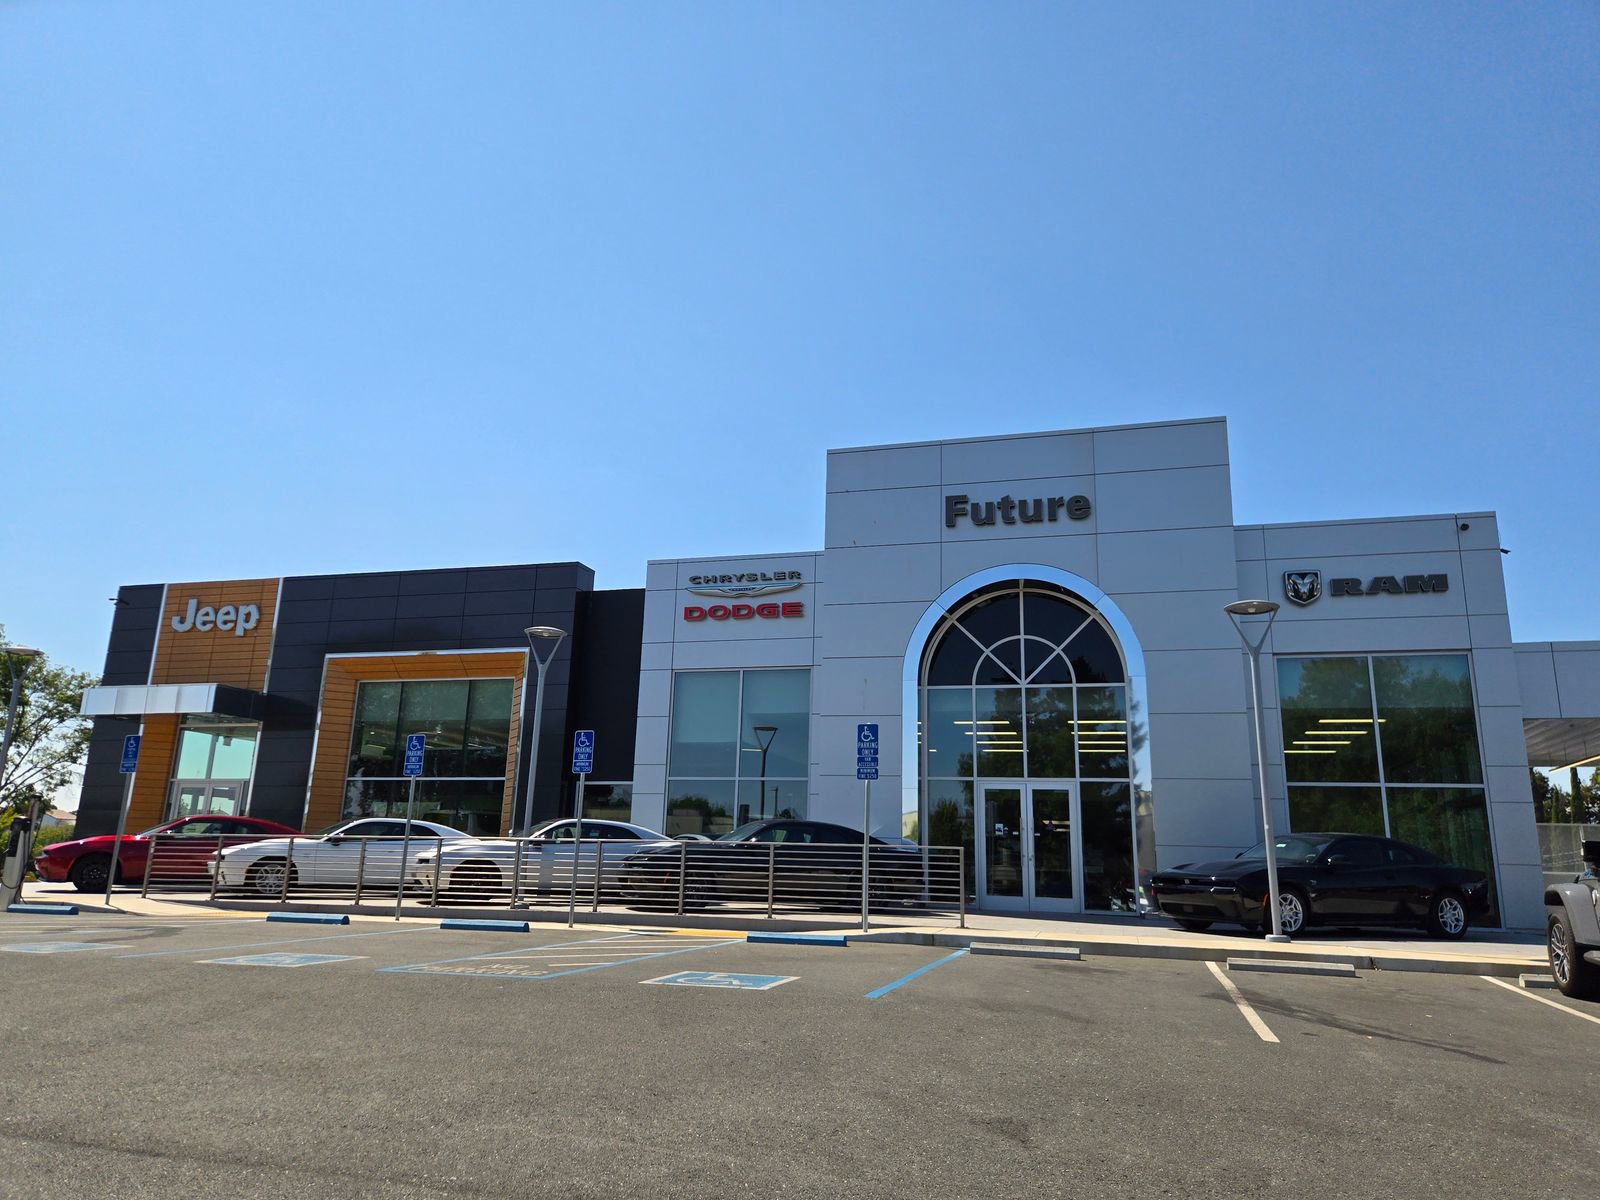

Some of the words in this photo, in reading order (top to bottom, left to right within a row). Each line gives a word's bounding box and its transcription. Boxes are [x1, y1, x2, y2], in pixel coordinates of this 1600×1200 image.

[945, 494, 1091, 528] Future
[688, 570, 802, 585] CHRYSLER
[1330, 573, 1449, 596] RAM
[171, 598, 260, 637] Jeep
[683, 601, 804, 621] DODGE
[858, 741, 878, 749] PARKING
